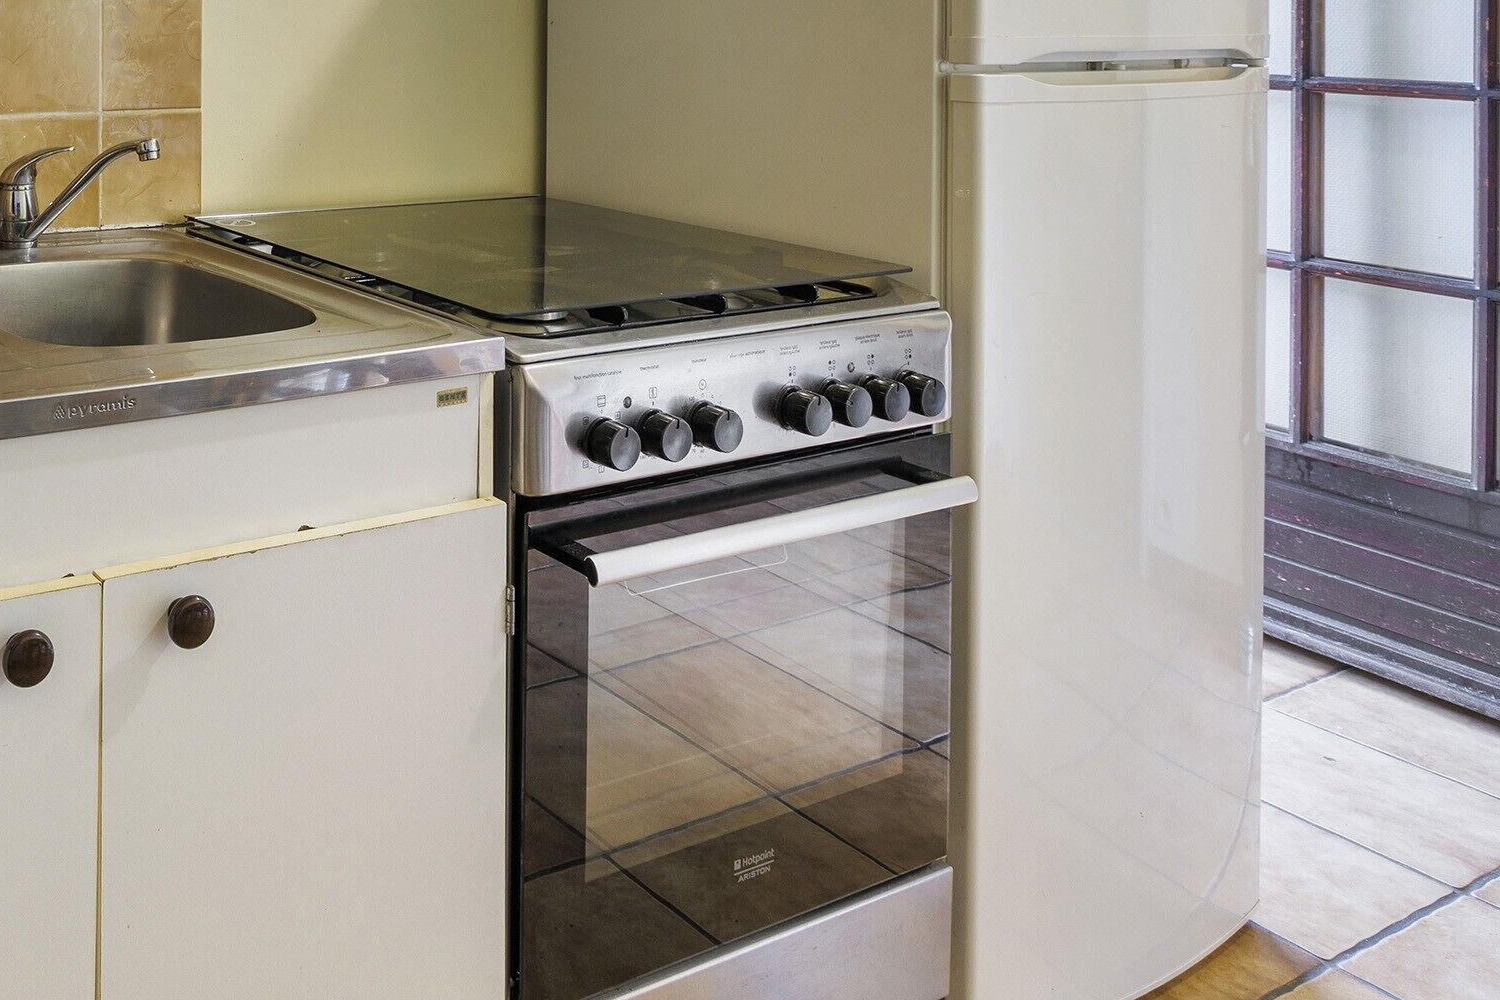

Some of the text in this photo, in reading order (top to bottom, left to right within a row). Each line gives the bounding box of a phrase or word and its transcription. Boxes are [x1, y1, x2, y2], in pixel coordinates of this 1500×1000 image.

[67, 395, 137, 419] pyramis
[742, 847, 775, 867] Hotpoint
[738, 865, 770, 883] ARISTON
